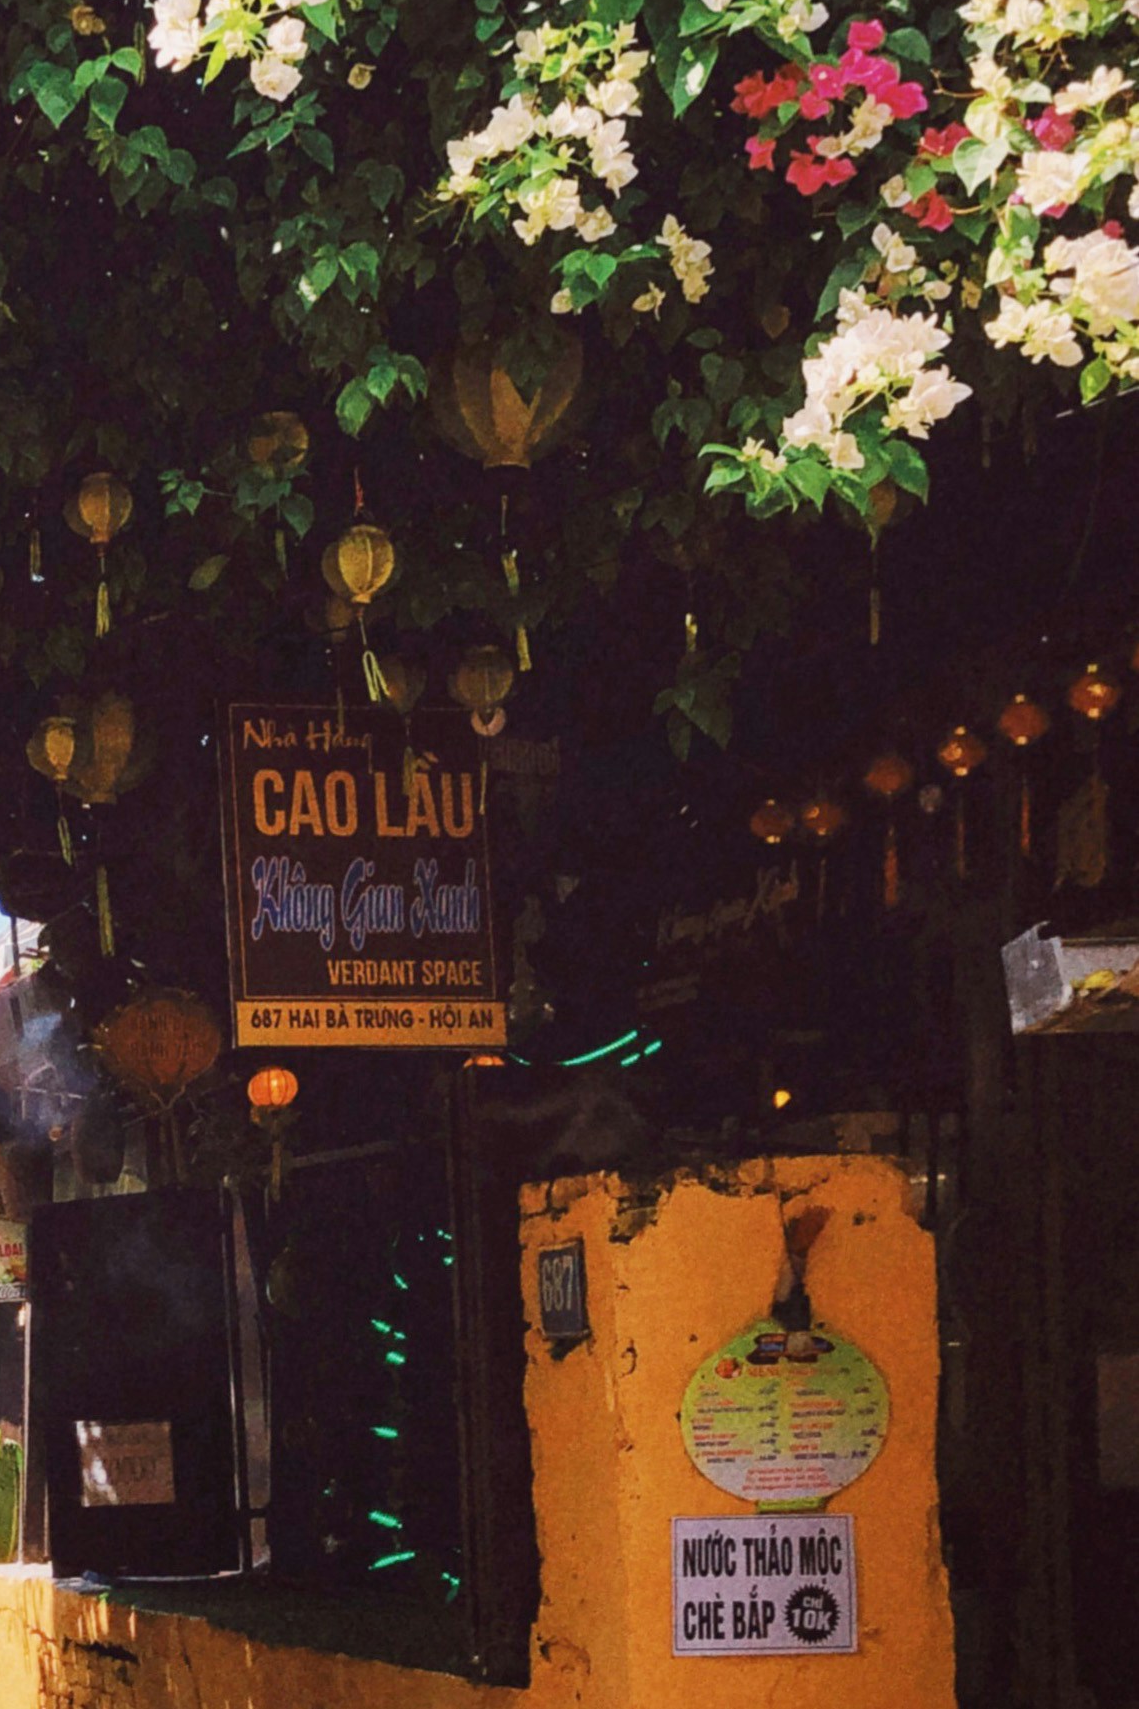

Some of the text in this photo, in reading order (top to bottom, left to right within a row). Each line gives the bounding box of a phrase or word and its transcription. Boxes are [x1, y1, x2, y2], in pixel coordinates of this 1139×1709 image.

[252, 769, 358, 837] CAO
[252, 855, 481, 952] Không Gian Xanh
[327, 959, 484, 986] VERDANT SPACE
[251, 1008, 282, 1029] 687
[288, 1008, 320, 1029] HAI
[326, 1003, 350, 1029] BÀ
[429, 1003, 462, 1036] HỘI
[469, 1008, 493, 1029] AN
[542, 1255, 573, 1312] 687
[682, 1523, 843, 1585] NƯỚC THẢO MỘC
[683, 1584, 776, 1641] CHÈ BẮP
[791, 1608, 833, 1631] 10K
